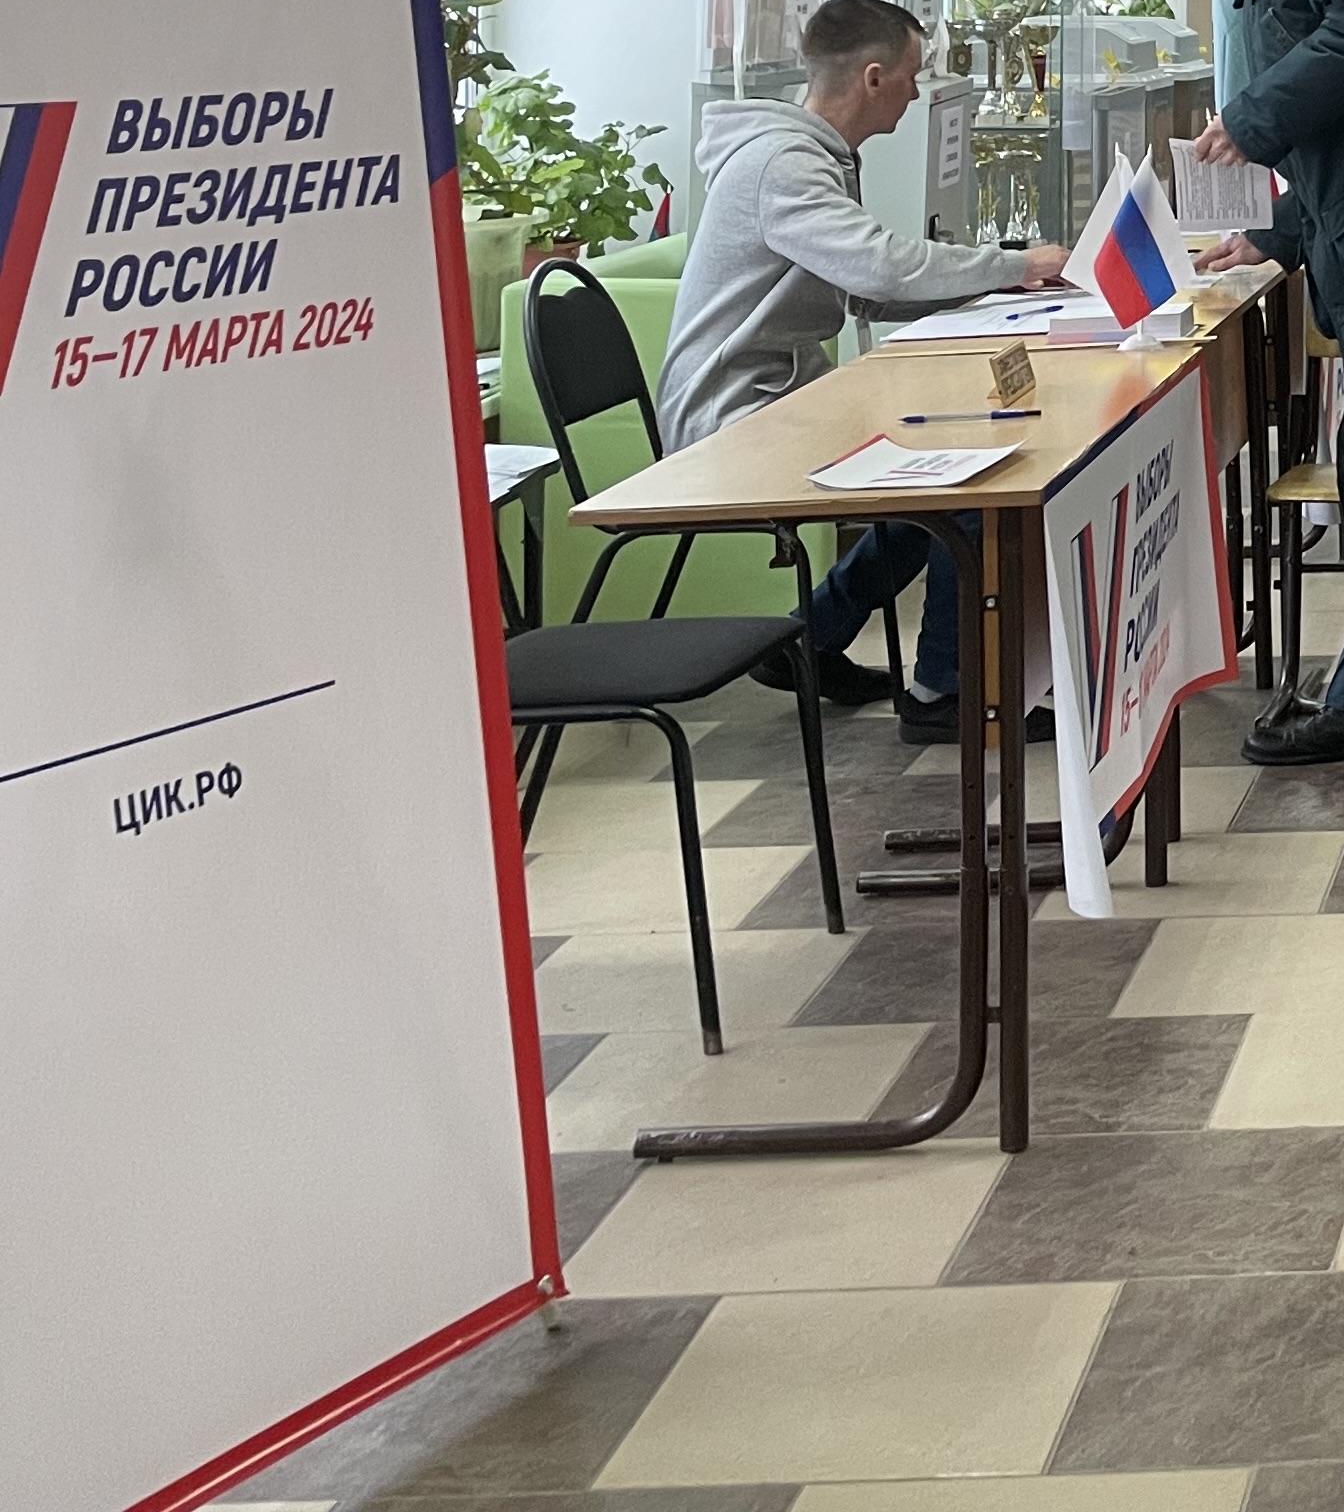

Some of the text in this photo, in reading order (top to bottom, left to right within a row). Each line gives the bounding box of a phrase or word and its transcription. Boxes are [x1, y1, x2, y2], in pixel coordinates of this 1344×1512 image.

[106, 88, 334, 155] ВЫБОРЫ
[85, 154, 401, 235] ПРЕЗИДЕНТА
[64, 239, 279, 318] РОССИИ
[51, 296, 375, 390] 15–17 МАРТА 2024
[113, 761, 242, 836] ЦИК.РФ
